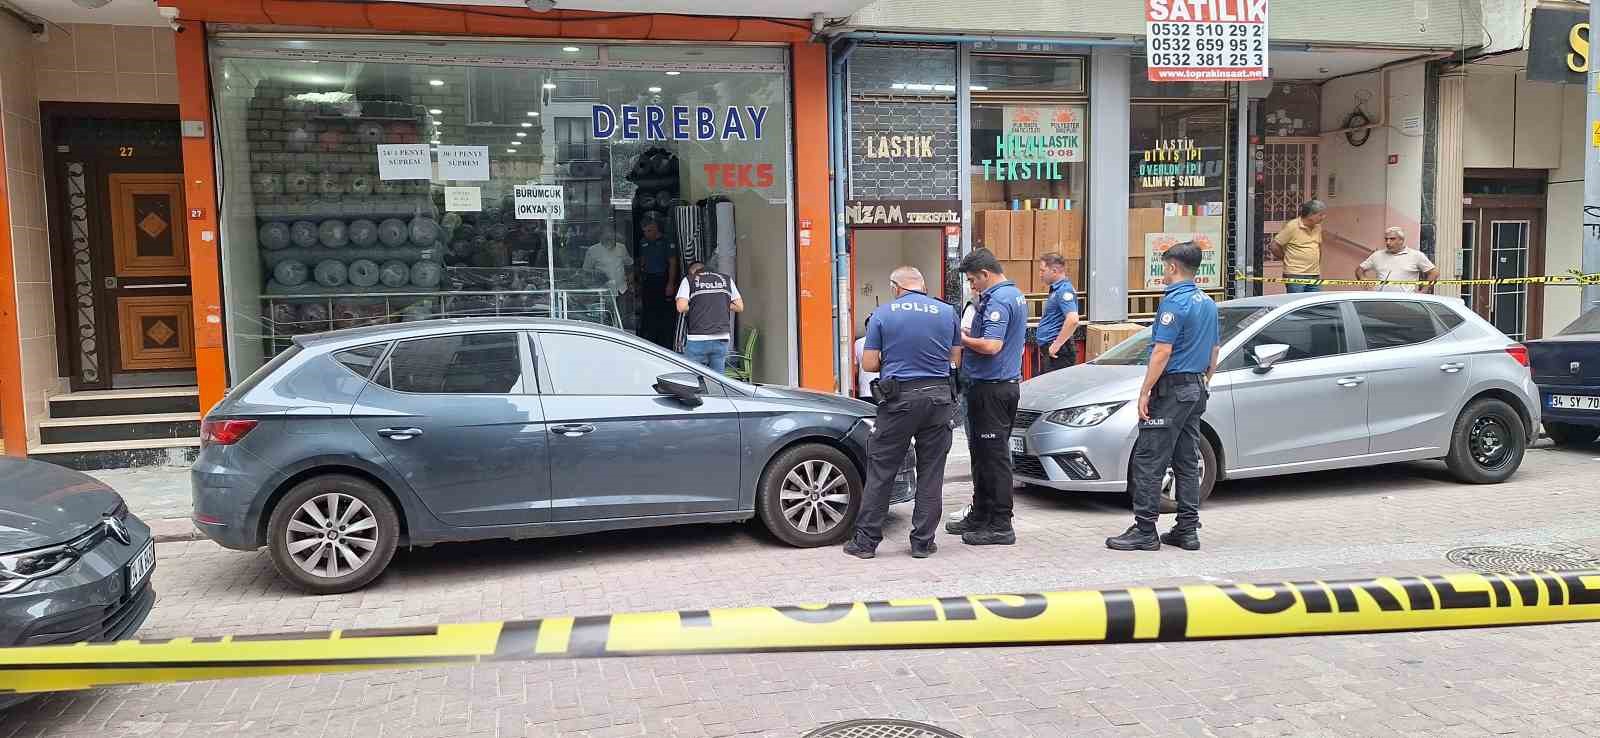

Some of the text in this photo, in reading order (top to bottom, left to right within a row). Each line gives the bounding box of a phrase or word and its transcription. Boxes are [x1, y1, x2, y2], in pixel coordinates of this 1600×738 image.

[1148, 0, 1264, 21] SATILIK
[1152, 23, 1190, 36] 0532
[1196, 23, 1224, 37] 510
[1229, 24, 1247, 37] 29
[1152, 38, 1190, 51] 0532
[1196, 38, 1224, 51] 659
[1229, 39, 1247, 51] 95
[1152, 53, 1190, 66] 0532
[1196, 53, 1223, 66] 381
[1230, 53, 1247, 66] 25
[591, 103, 769, 141] DEREBAY
[119, 147, 134, 157] 27
[703, 163, 775, 189] TEKS
[1164, 176, 1176, 187] VE
[845, 201, 903, 224] NİZAM
[1553, 396, 1563, 406] 34
[1570, 397, 1581, 407] SY
